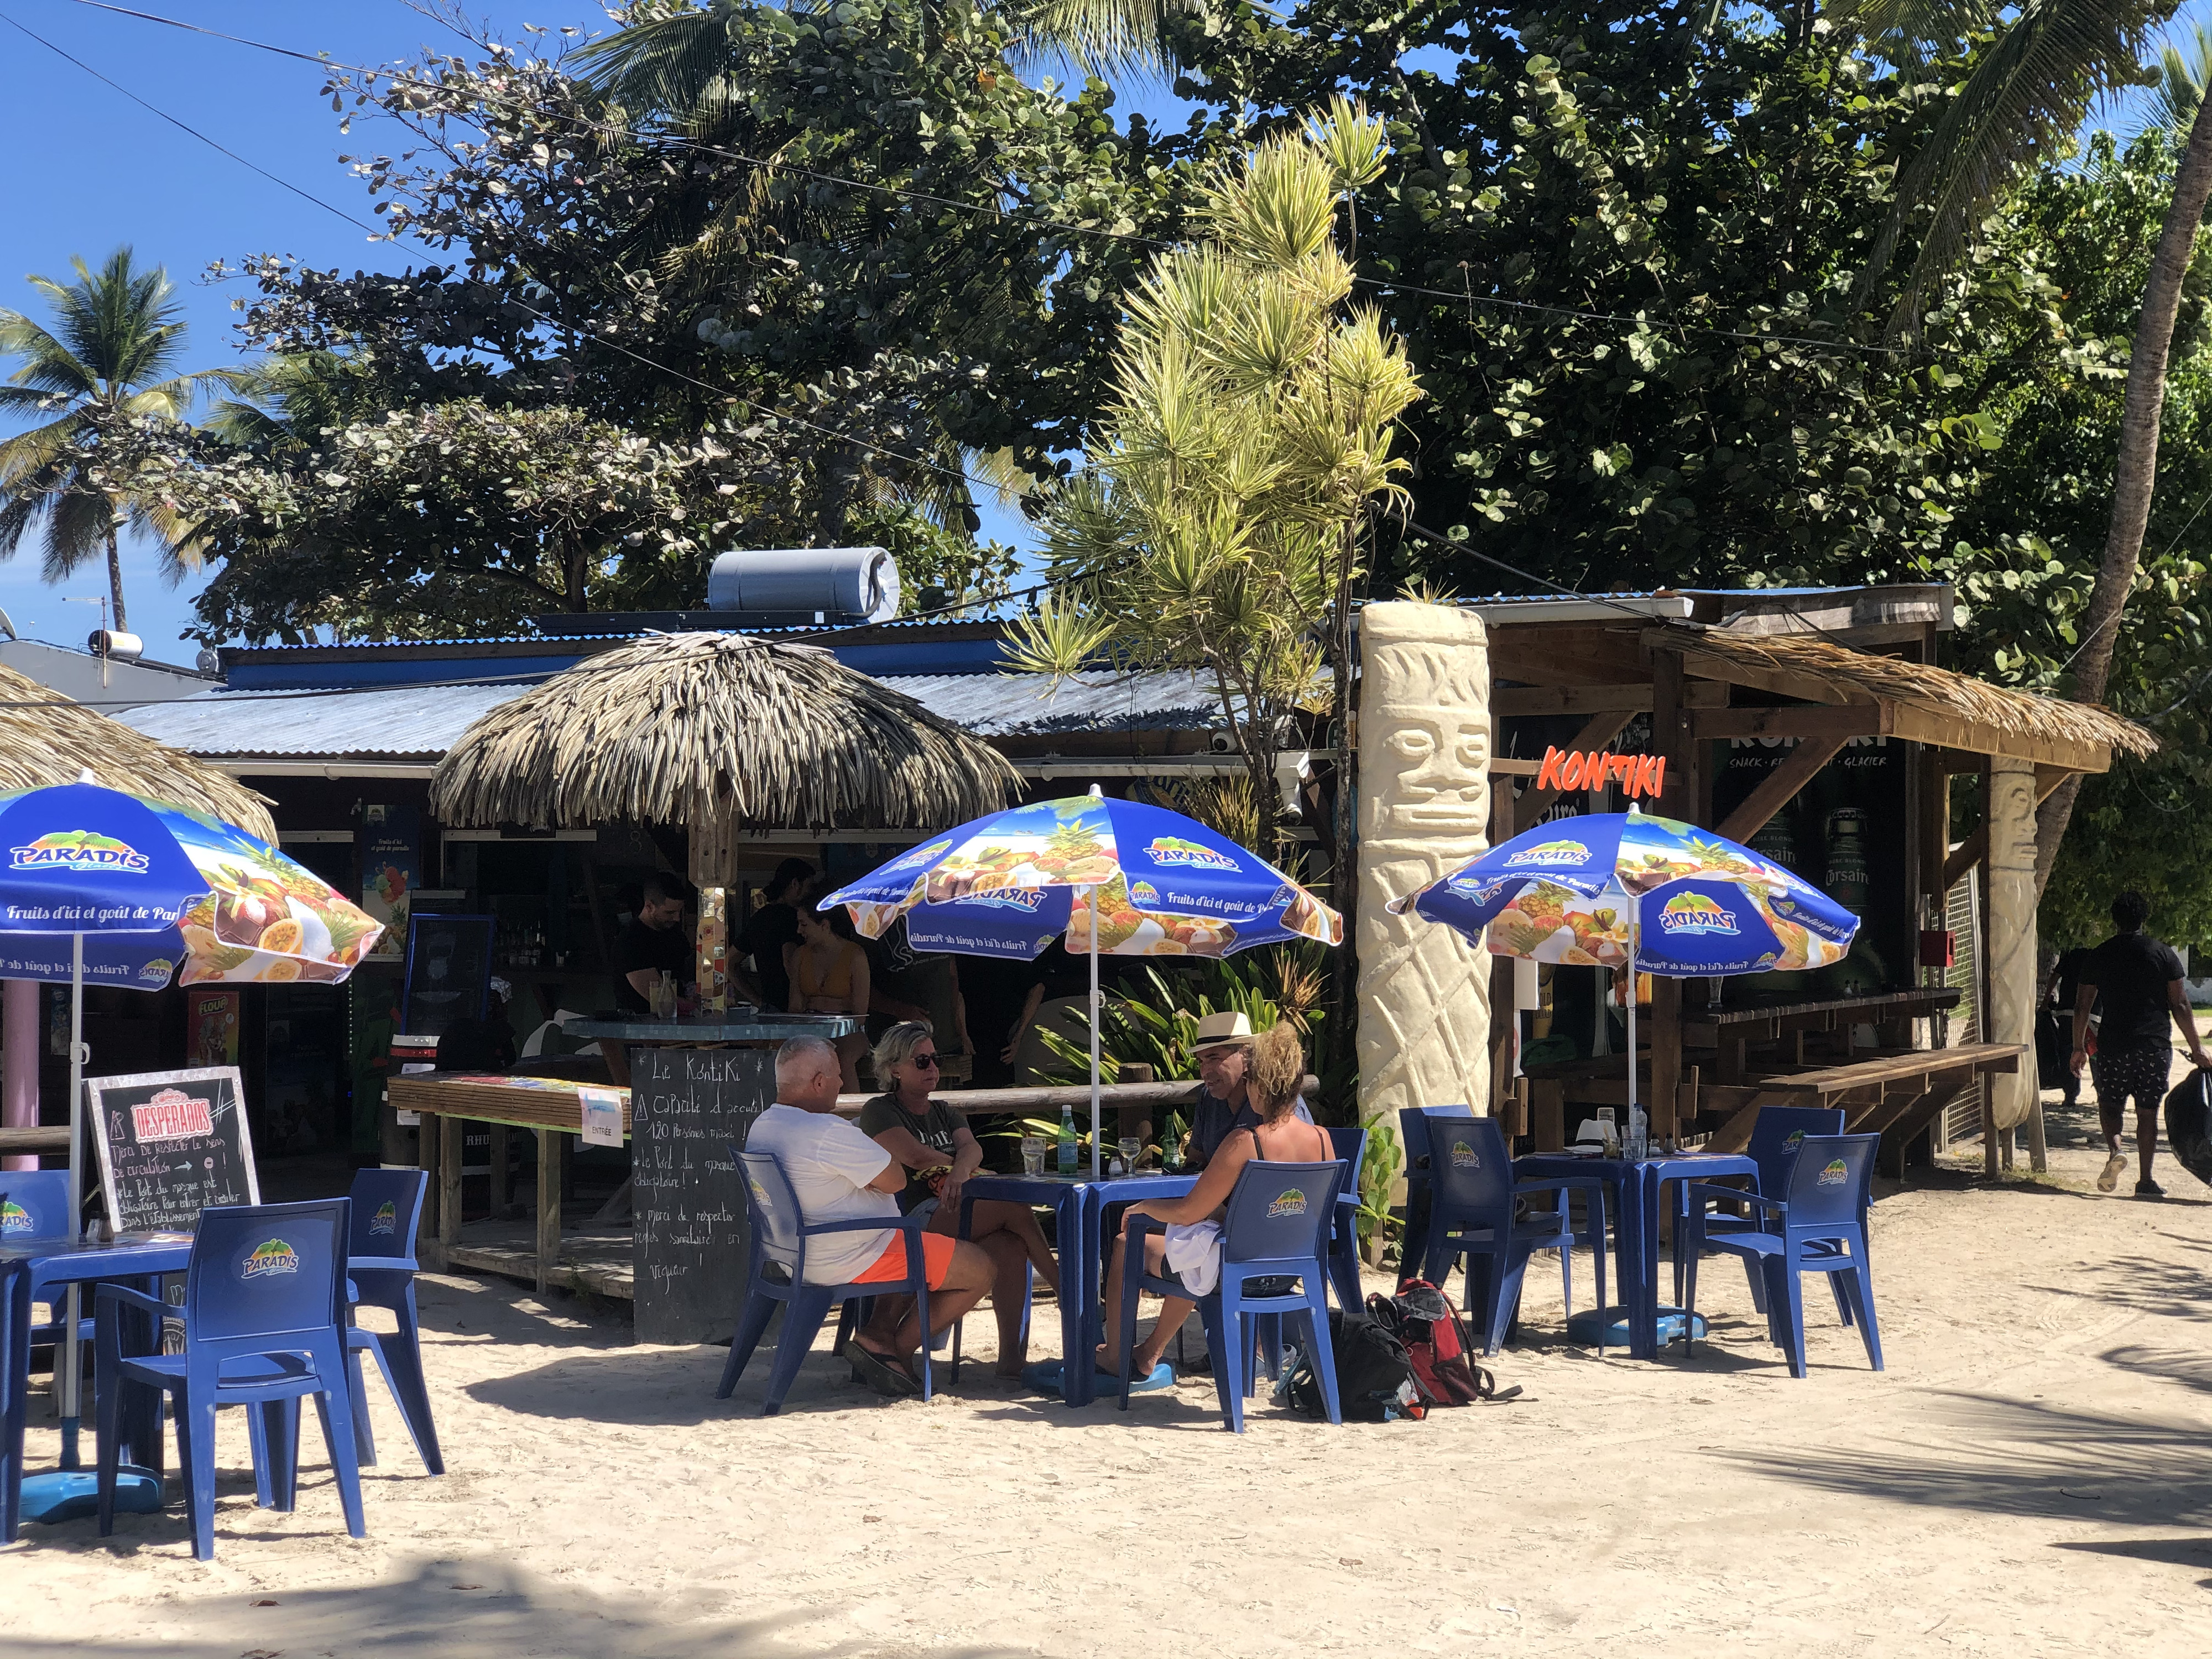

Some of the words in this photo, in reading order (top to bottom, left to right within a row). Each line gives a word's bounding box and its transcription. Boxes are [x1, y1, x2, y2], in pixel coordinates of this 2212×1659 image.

[1729, 757, 1762, 768] SNACK
[1844, 756, 1887, 767] GLACIER
[1537, 745, 1666, 799] KONTIKI
[1167, 891, 1194, 905] Fruits
[1196, 895, 1214, 907] d'ici
[1214, 898, 1223, 909] et
[1224, 900, 1244, 913] goût
[1244, 902, 1256, 913] de
[6, 905, 50, 919] Fruits
[53, 905, 81, 919] d'ici
[83, 906, 95, 919] et
[98, 905, 130, 924] goût
[132, 906, 149, 919] de
[652, 1052, 670, 1080] Le
[135, 1102, 210, 1138] DESPERADOS
[592, 1125, 612, 1136] ENTRÉE
[646, 1120, 669, 1140] 120
[680, 1146, 695, 1170] du
[1451, 1152, 1479, 1164] PARADIS
[1819, 1171, 1848, 1182] PARADIS
[202, 1191, 212, 1207] et
[1269, 1201, 1307, 1213] PARADIS
[678, 1203, 690, 1222] de
[728, 1234, 740, 1244] en
[243, 1253, 298, 1274] PARADIS
